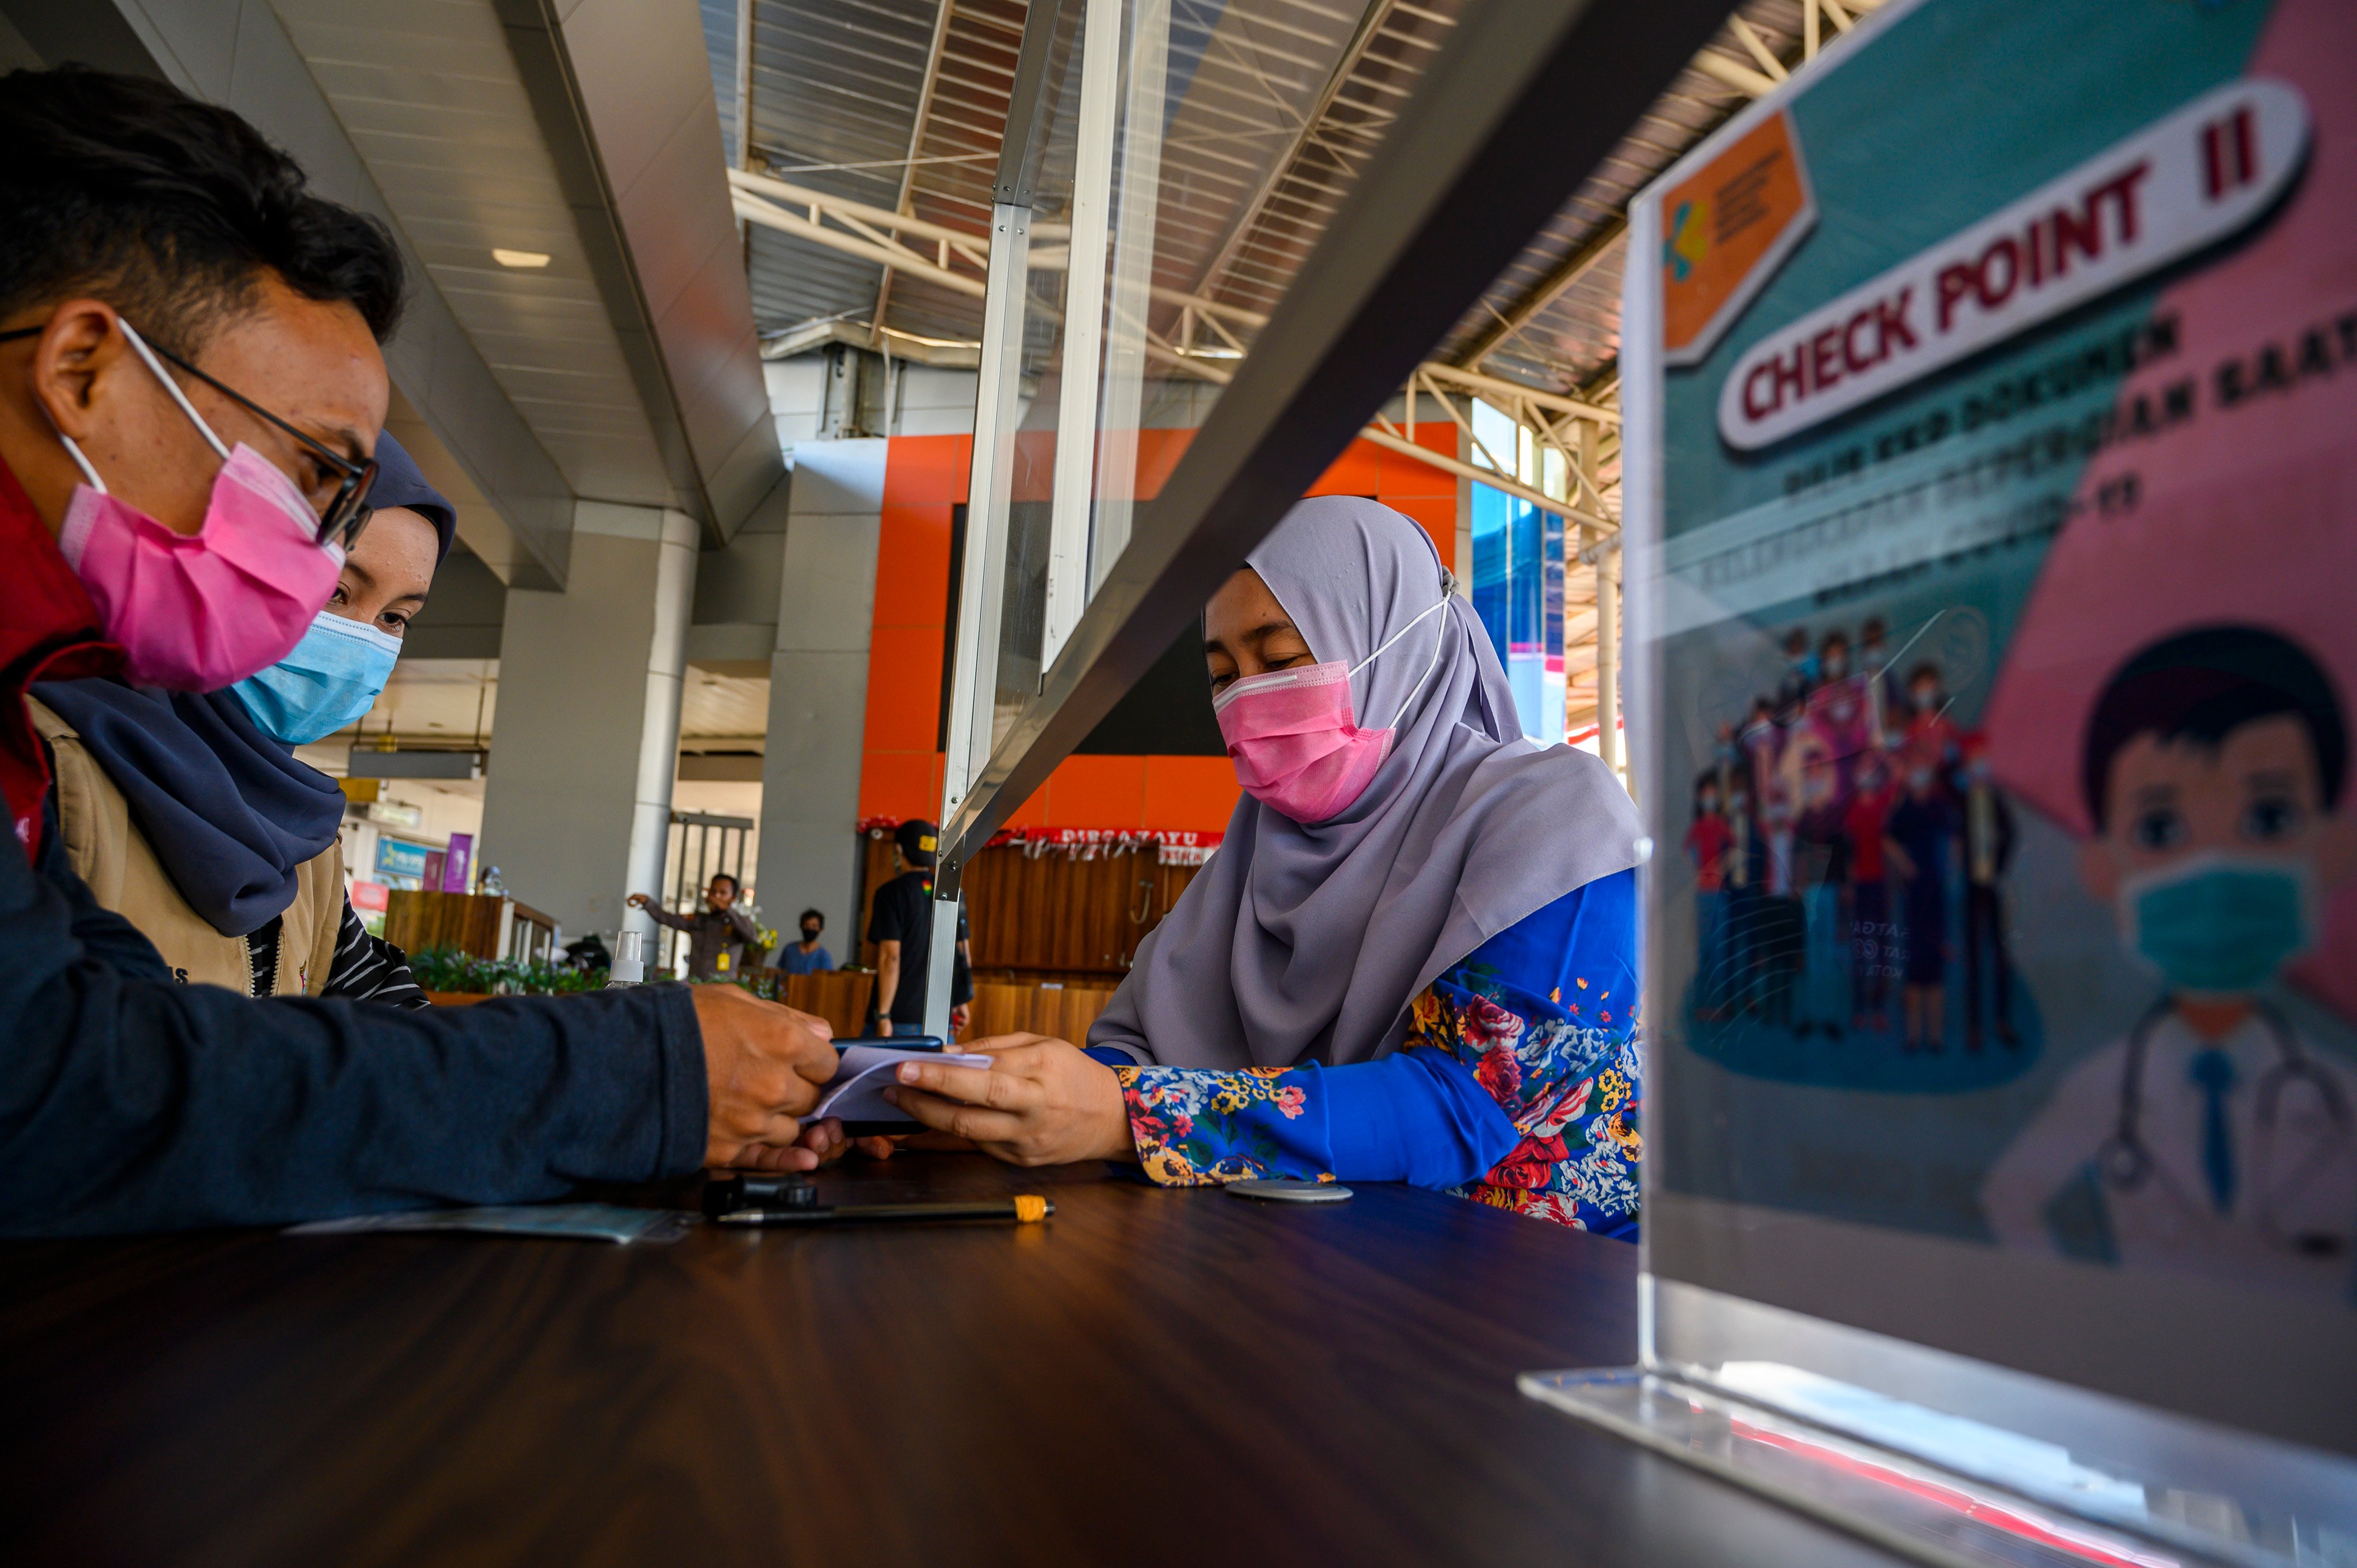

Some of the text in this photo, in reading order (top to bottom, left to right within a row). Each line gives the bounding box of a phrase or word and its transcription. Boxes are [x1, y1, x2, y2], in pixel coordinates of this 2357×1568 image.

[1742, 285, 1919, 424] CHECK
[1935, 156, 2153, 332] POINT
[2200, 105, 2256, 199] II
